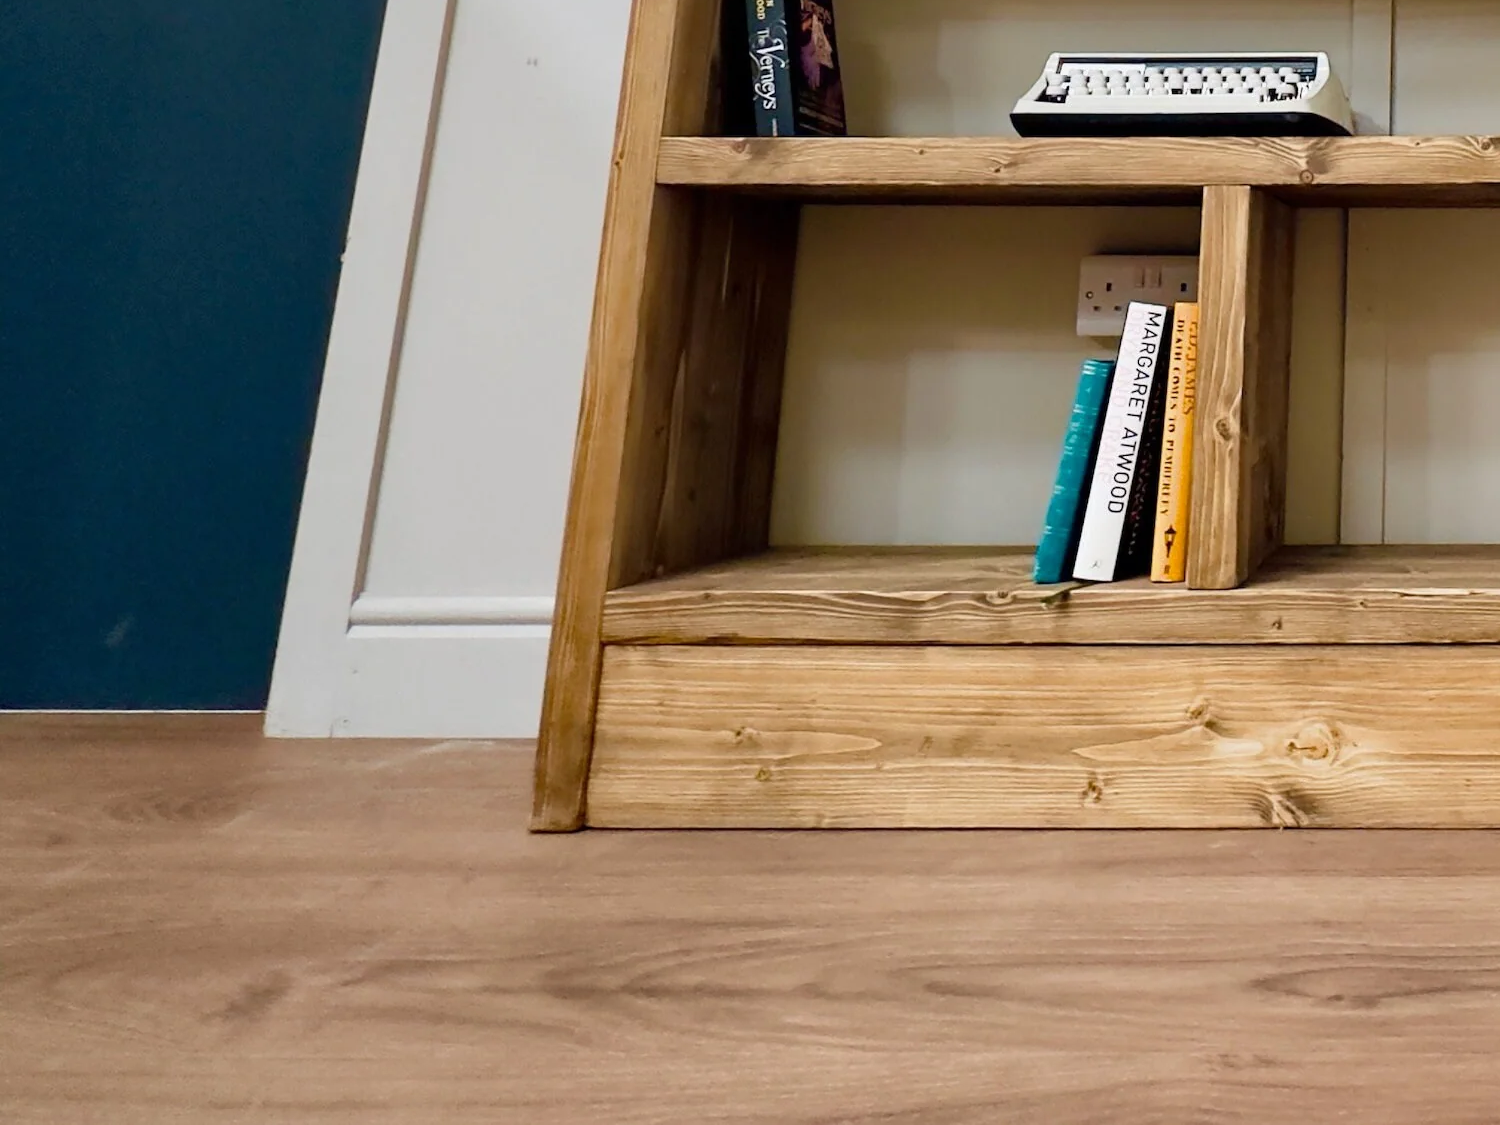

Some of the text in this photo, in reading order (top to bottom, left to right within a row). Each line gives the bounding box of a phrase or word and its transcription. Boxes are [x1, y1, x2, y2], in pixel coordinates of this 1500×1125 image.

[755, 38, 785, 109] Verneys
[1127, 312, 1162, 421] MARGARET
[1182, 354, 1198, 415] JAMES
[1160, 319, 1185, 517] DEATH COMES TO PEMBERLEY
[1108, 427, 1138, 514] ATWOOD
